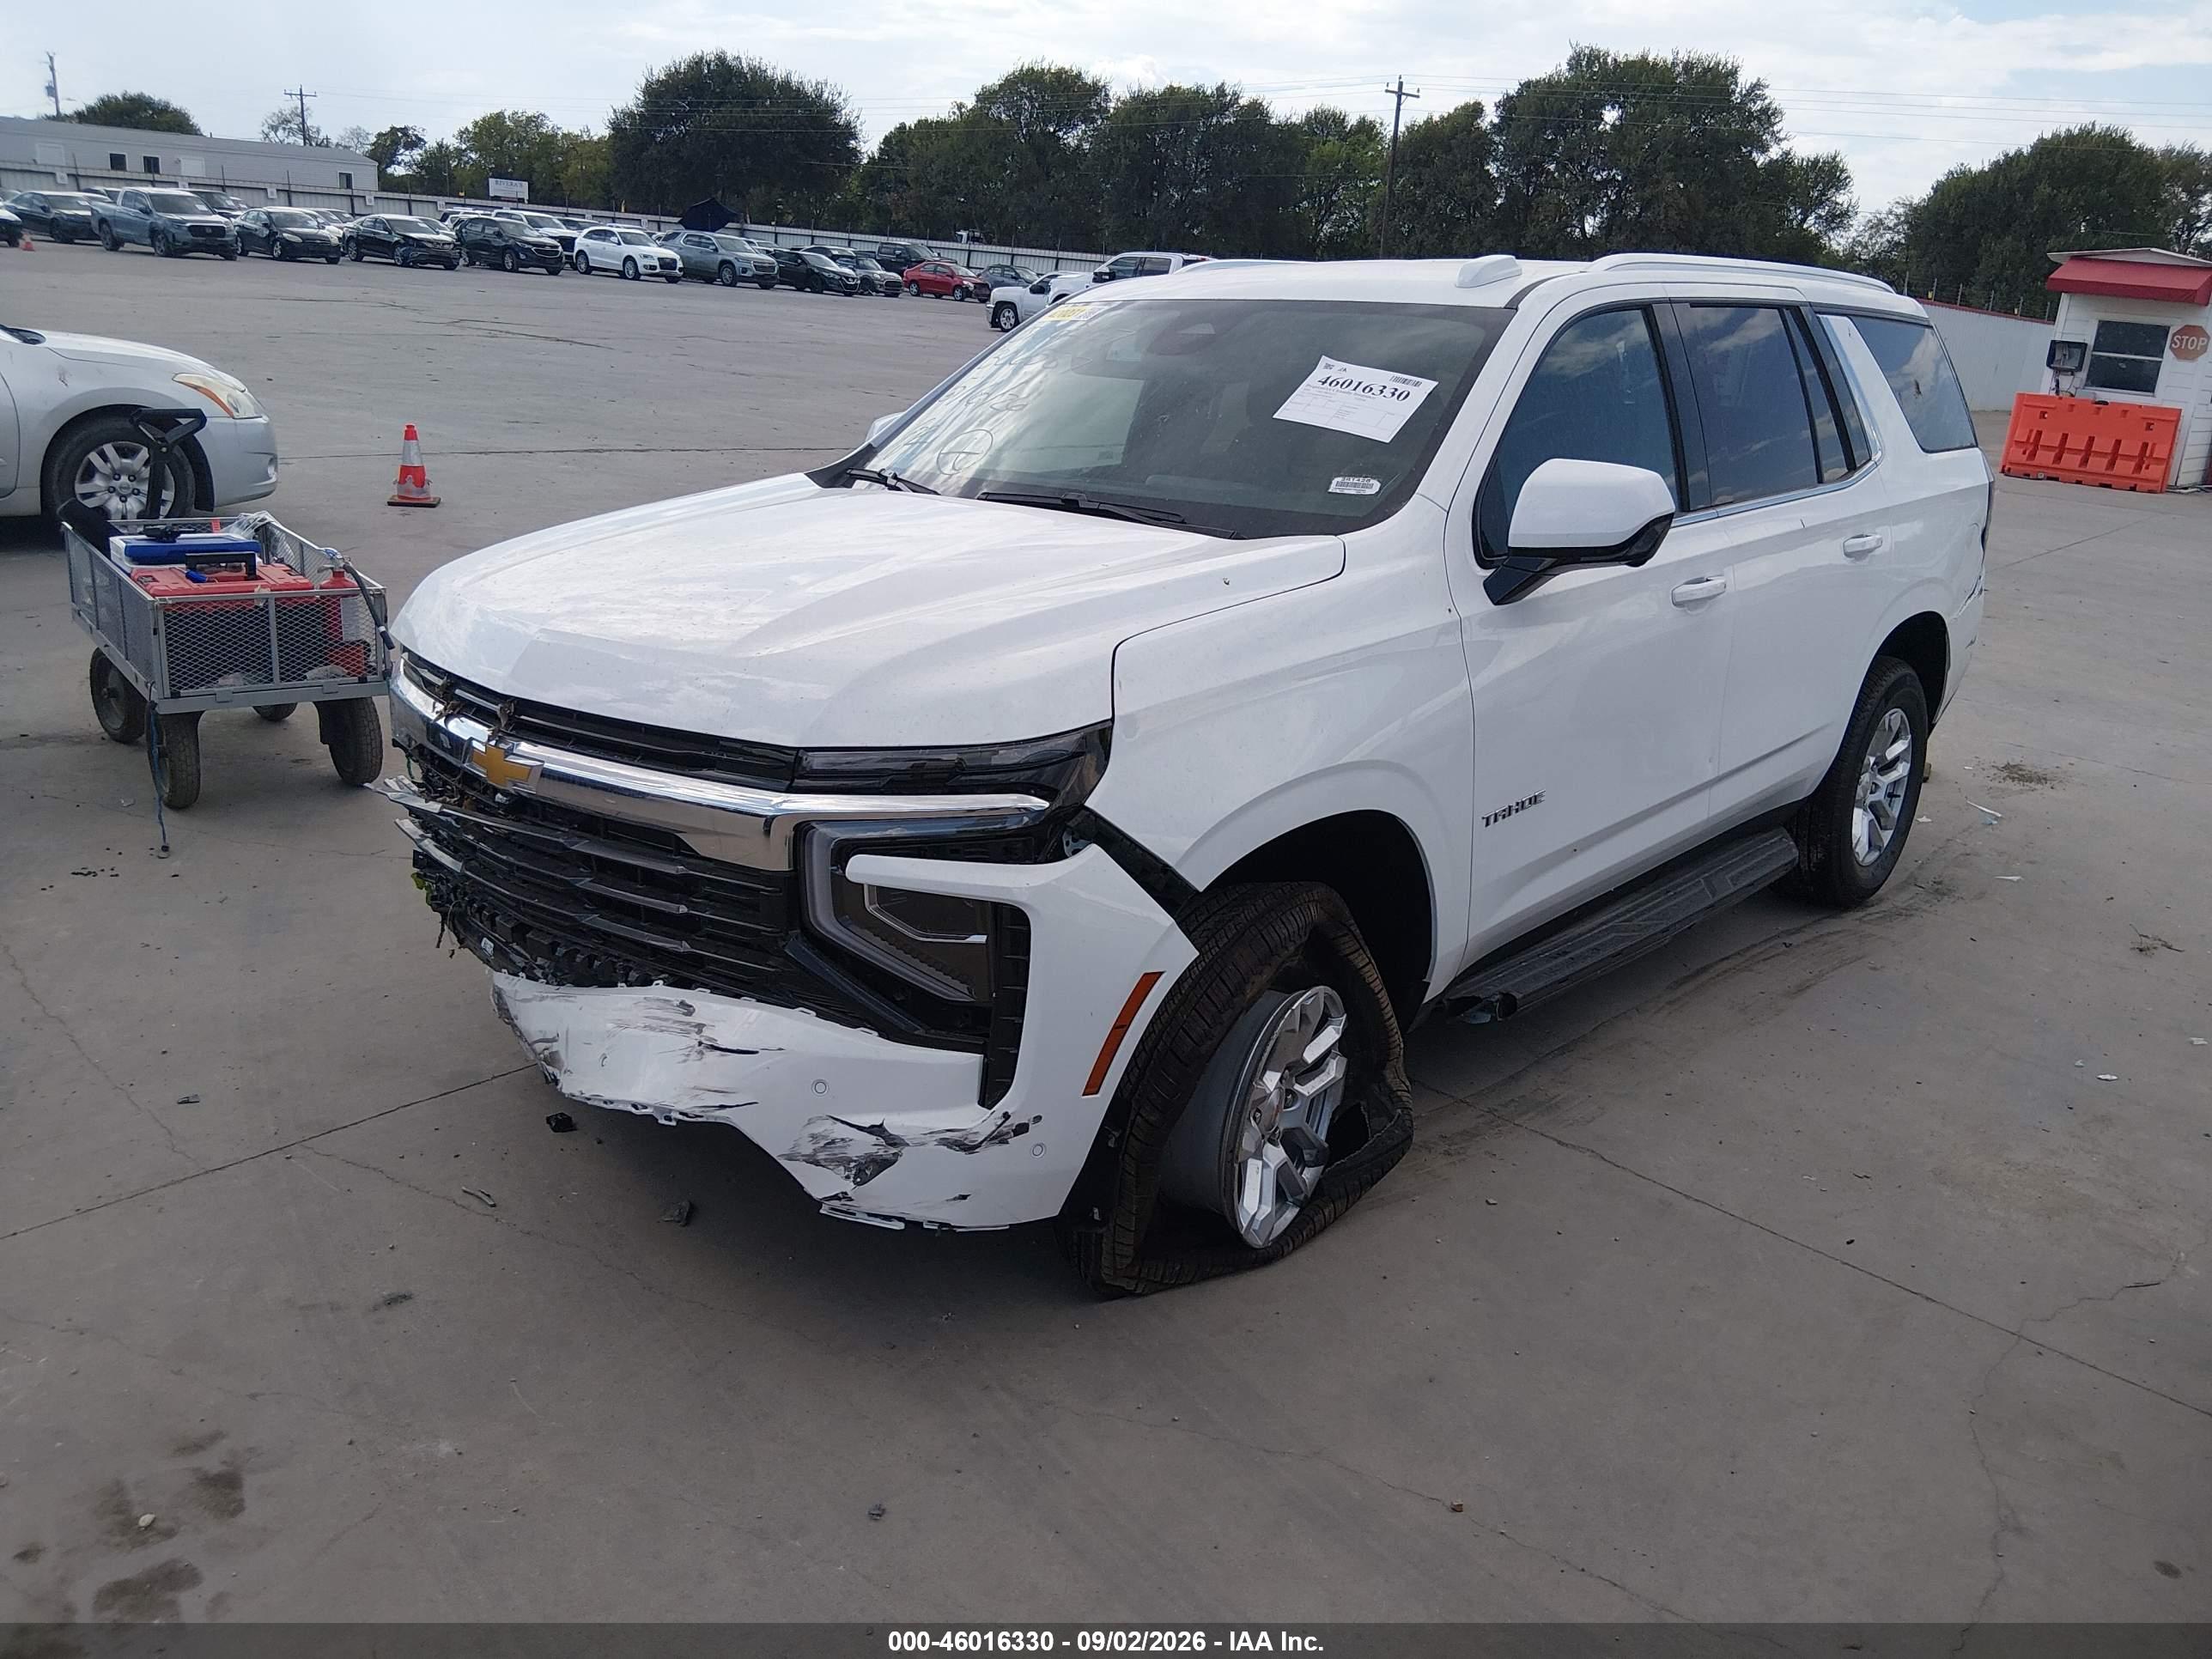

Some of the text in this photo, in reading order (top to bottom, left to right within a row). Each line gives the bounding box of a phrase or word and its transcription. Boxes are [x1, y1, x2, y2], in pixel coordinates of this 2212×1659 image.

[2172, 335, 2207, 350] STOP
[1317, 375, 1411, 402] 46016330
[1481, 789, 1547, 828] TAHOE
